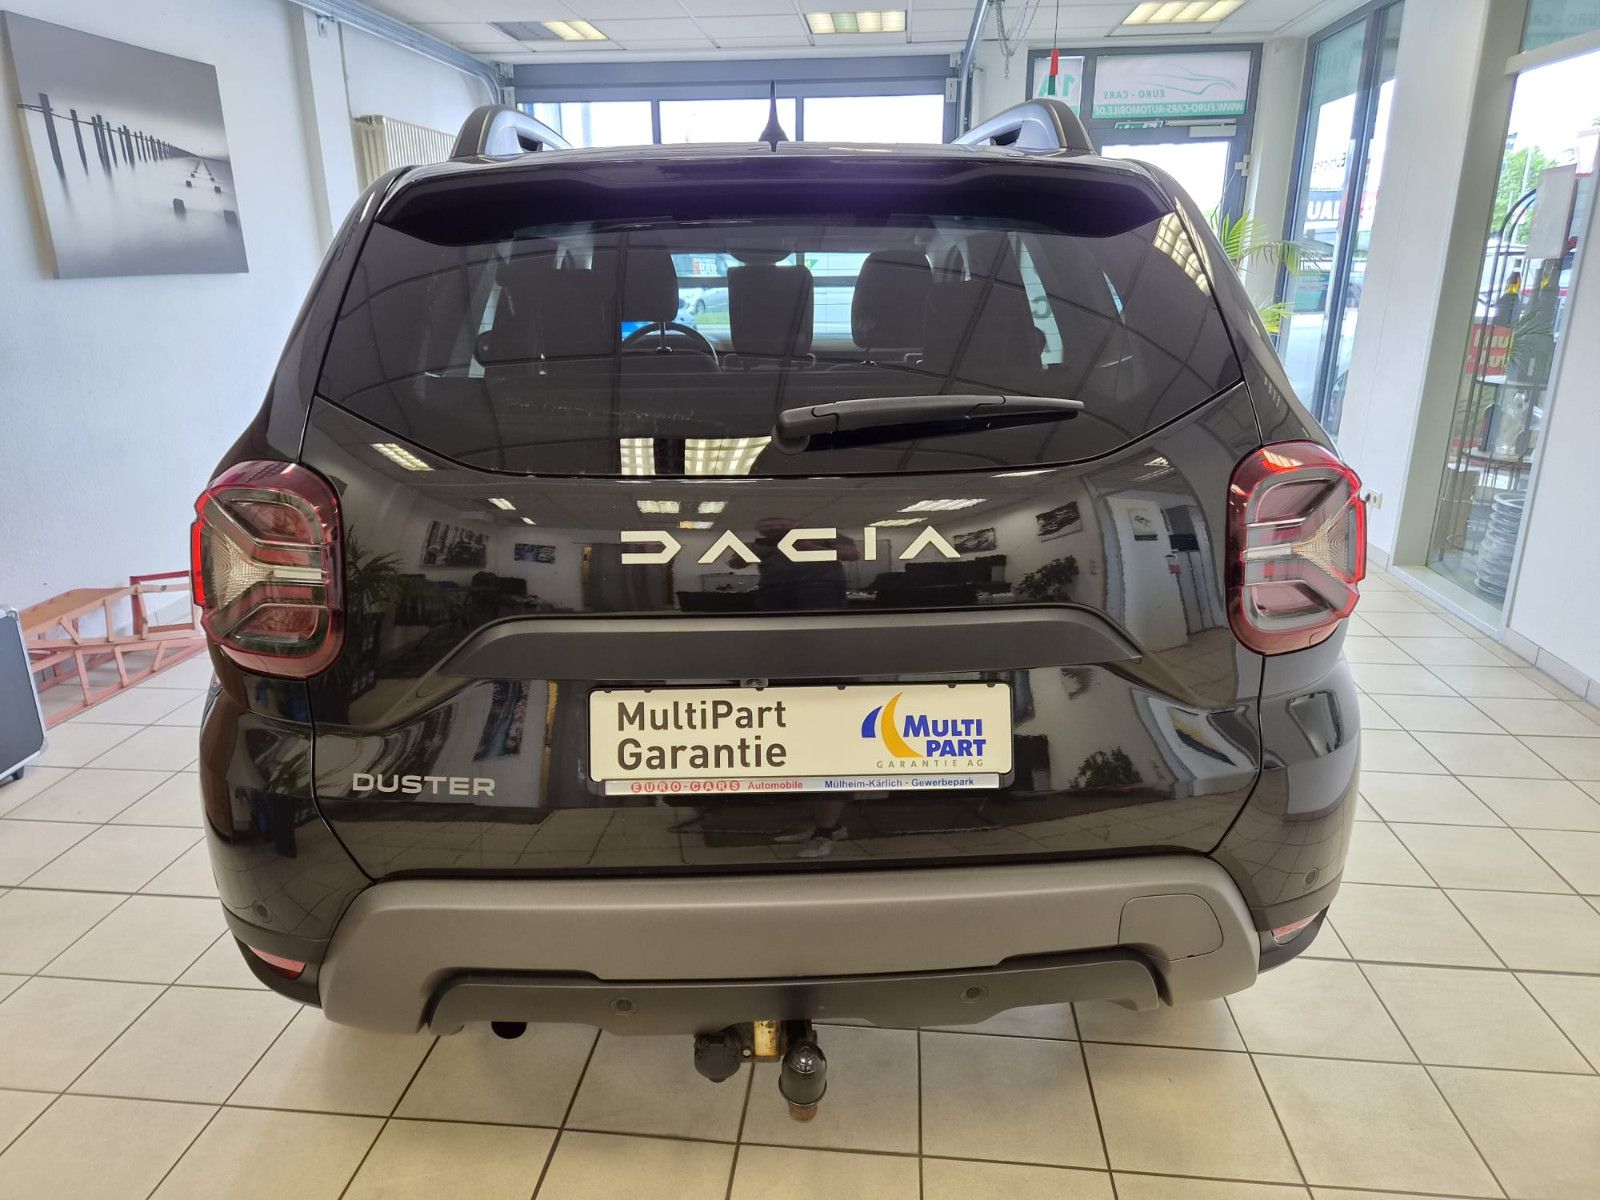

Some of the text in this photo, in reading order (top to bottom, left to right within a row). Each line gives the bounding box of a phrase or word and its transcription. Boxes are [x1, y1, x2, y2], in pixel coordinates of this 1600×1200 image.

[621, 525, 961, 565] DACIA
[617, 700, 787, 732] MultiPart
[903, 714, 983, 737] MULTI
[617, 735, 787, 770] Garantie
[926, 739, 986, 757] PART
[876, 759, 984, 769] GARANTIE AG
[352, 773, 496, 797] DUSTER
[630, 780, 803, 793] EURO-CARS Automobile
[824, 779, 902, 788] Mülheim-Kärlich
[911, 778, 974, 788] Gewerbepark
